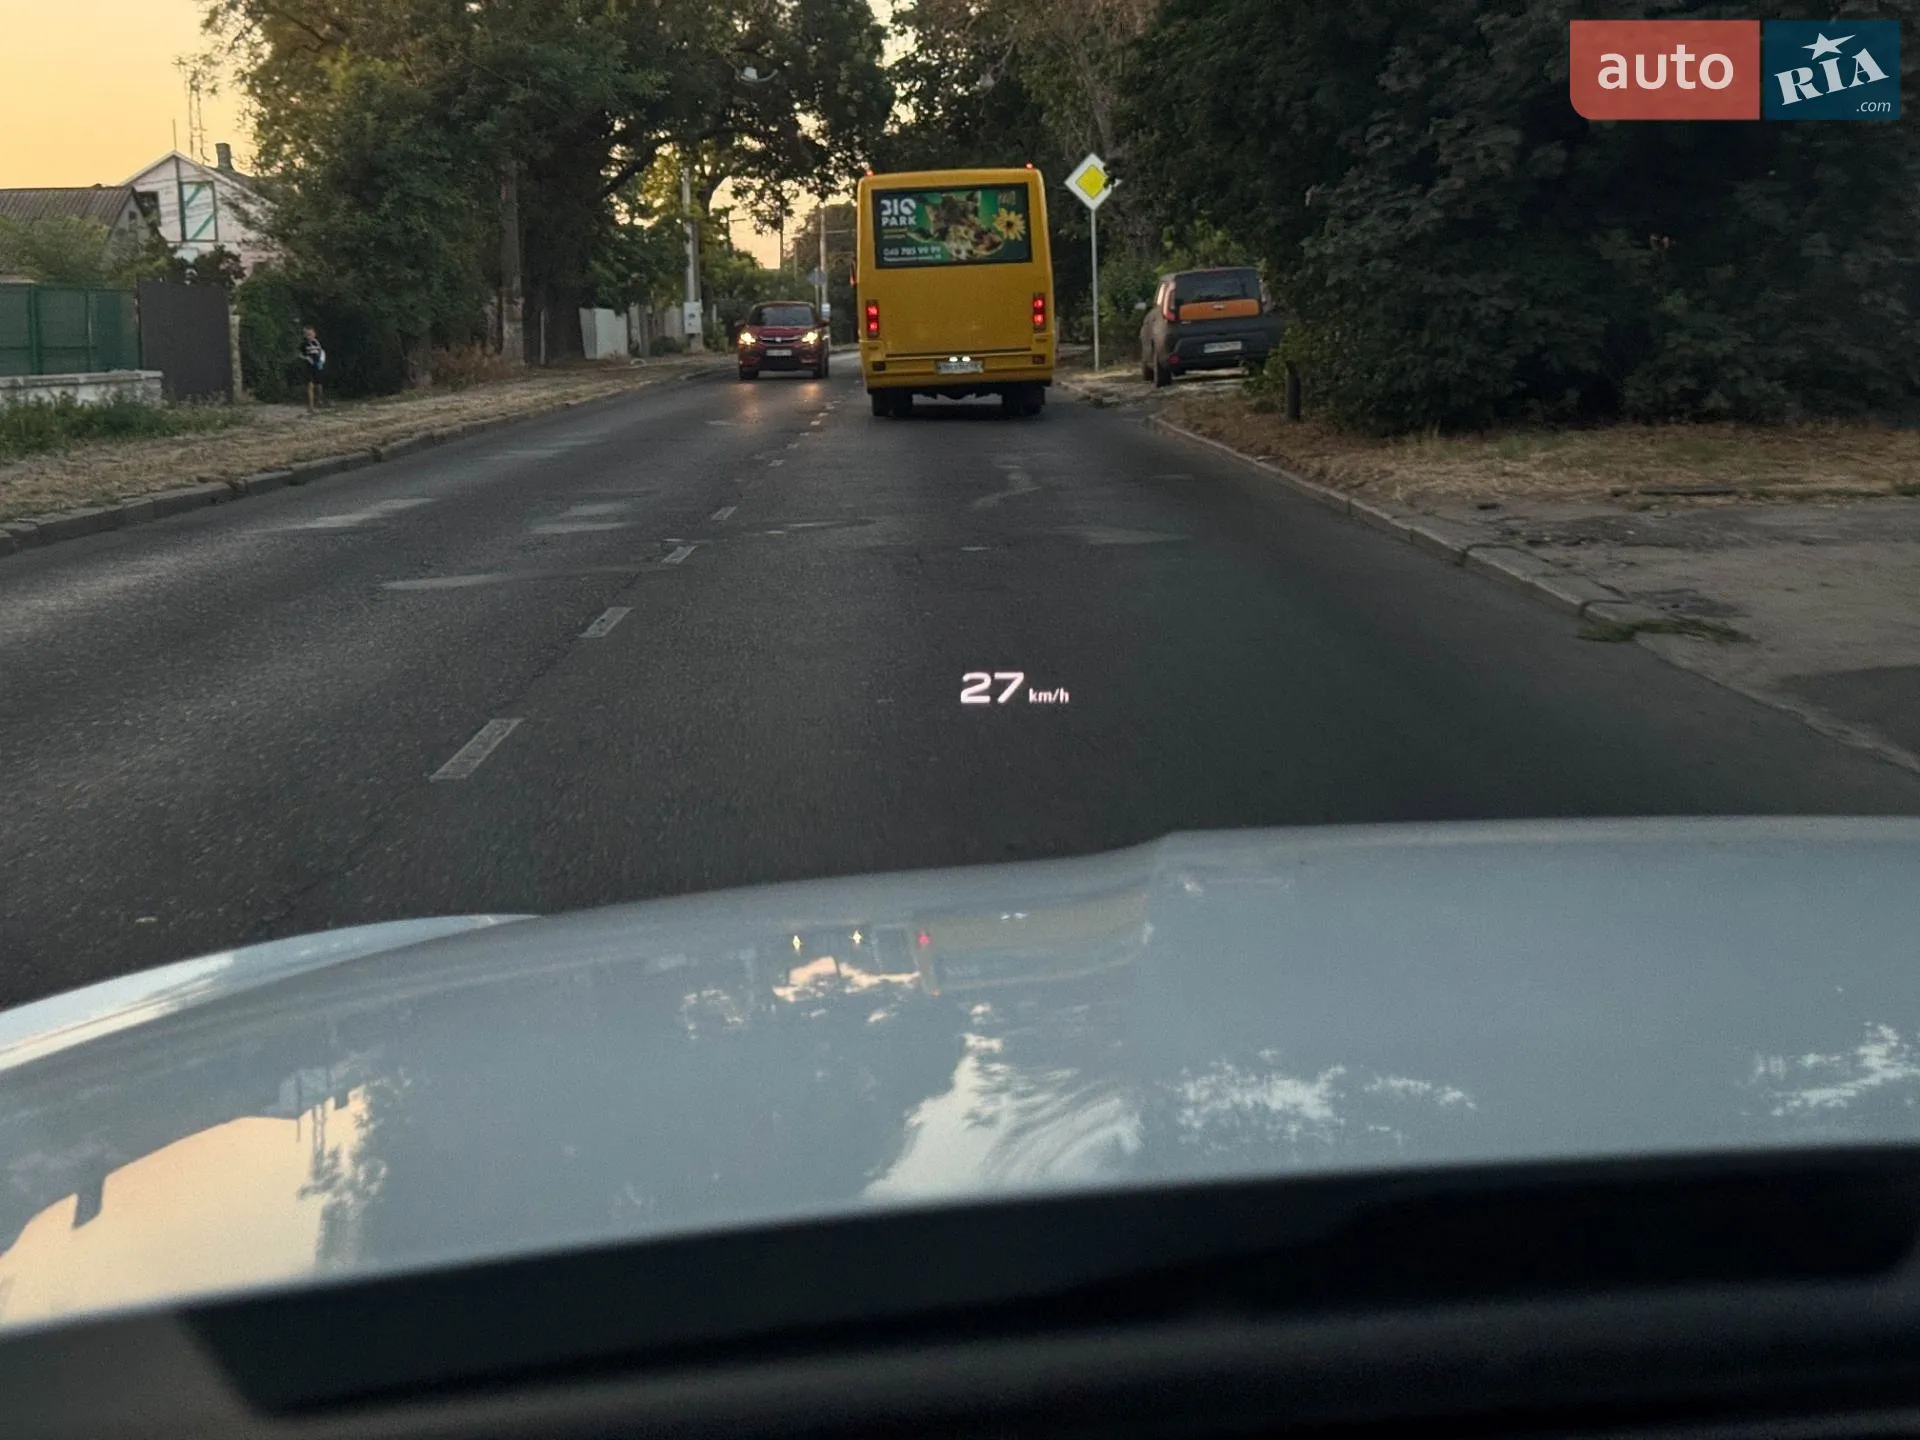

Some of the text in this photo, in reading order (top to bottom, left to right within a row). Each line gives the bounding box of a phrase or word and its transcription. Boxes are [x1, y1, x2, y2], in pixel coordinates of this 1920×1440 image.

[881, 215, 917, 227] PARK
[961, 672, 1069, 703] 27 km/h
